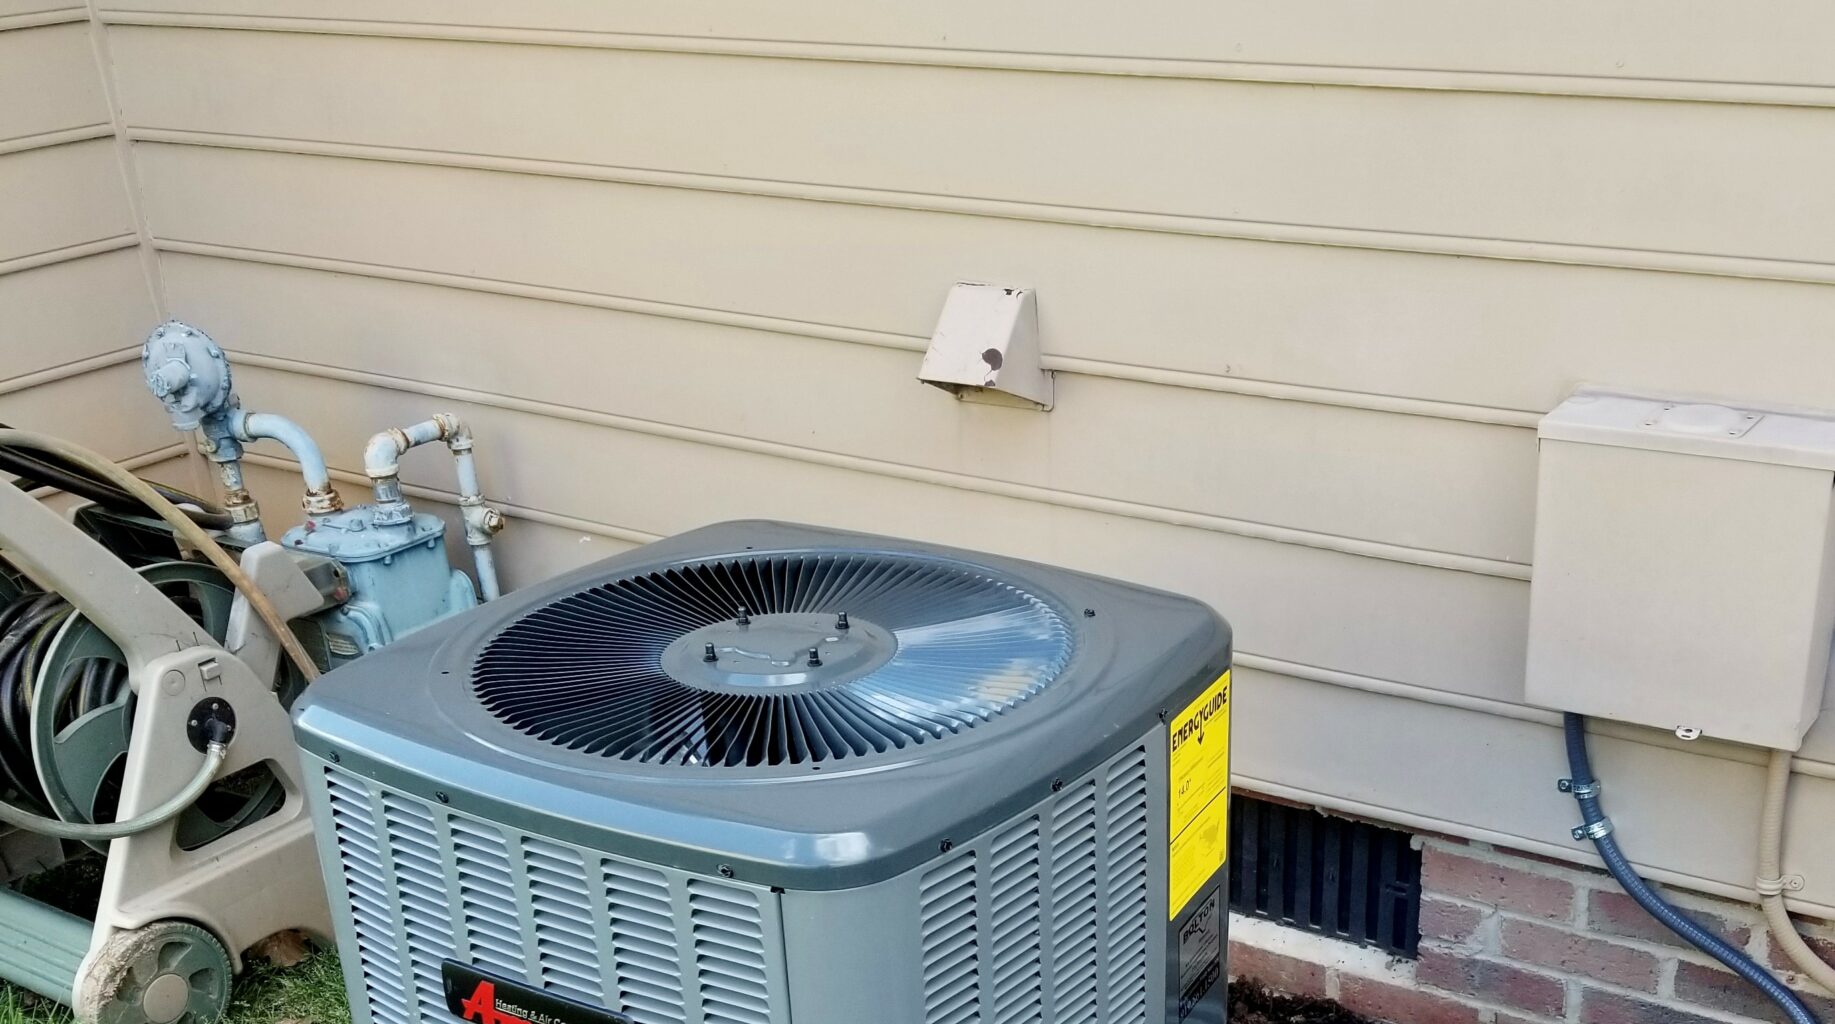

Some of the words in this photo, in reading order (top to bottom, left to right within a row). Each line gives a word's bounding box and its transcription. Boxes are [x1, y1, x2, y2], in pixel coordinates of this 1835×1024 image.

[495, 998, 528, 1019] Heating
[530, 1010, 538, 1020] &
[538, 1013, 552, 1024] Air
